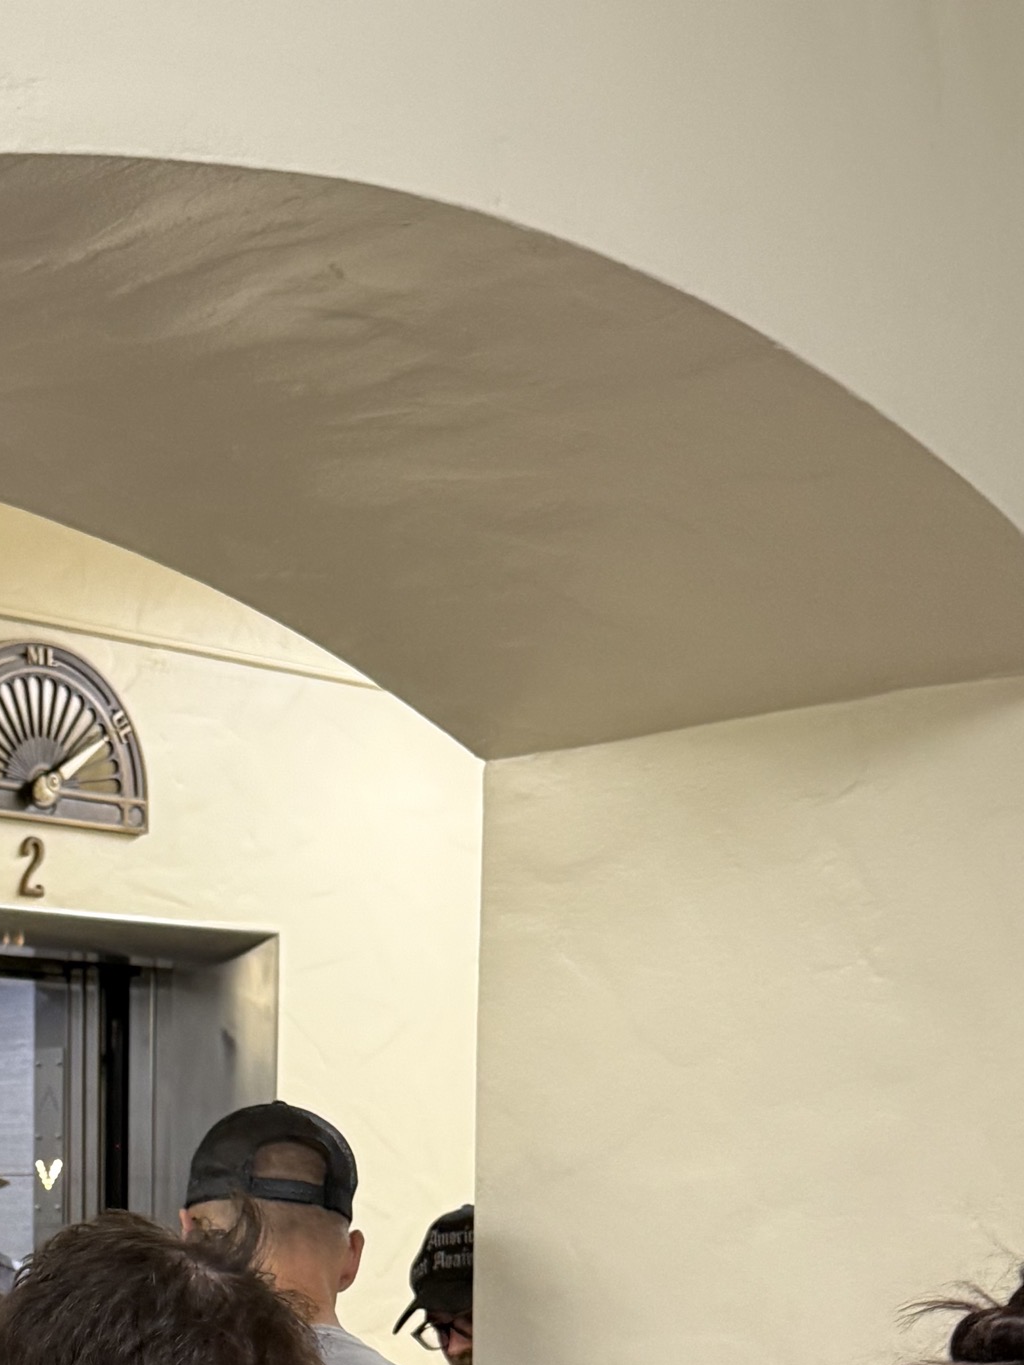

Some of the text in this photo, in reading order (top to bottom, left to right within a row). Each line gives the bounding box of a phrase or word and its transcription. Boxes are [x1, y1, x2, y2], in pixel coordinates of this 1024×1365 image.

[112, 710, 132, 744] UL
[17, 836, 45, 898] 2
[426, 1226, 474, 1251] Americ
